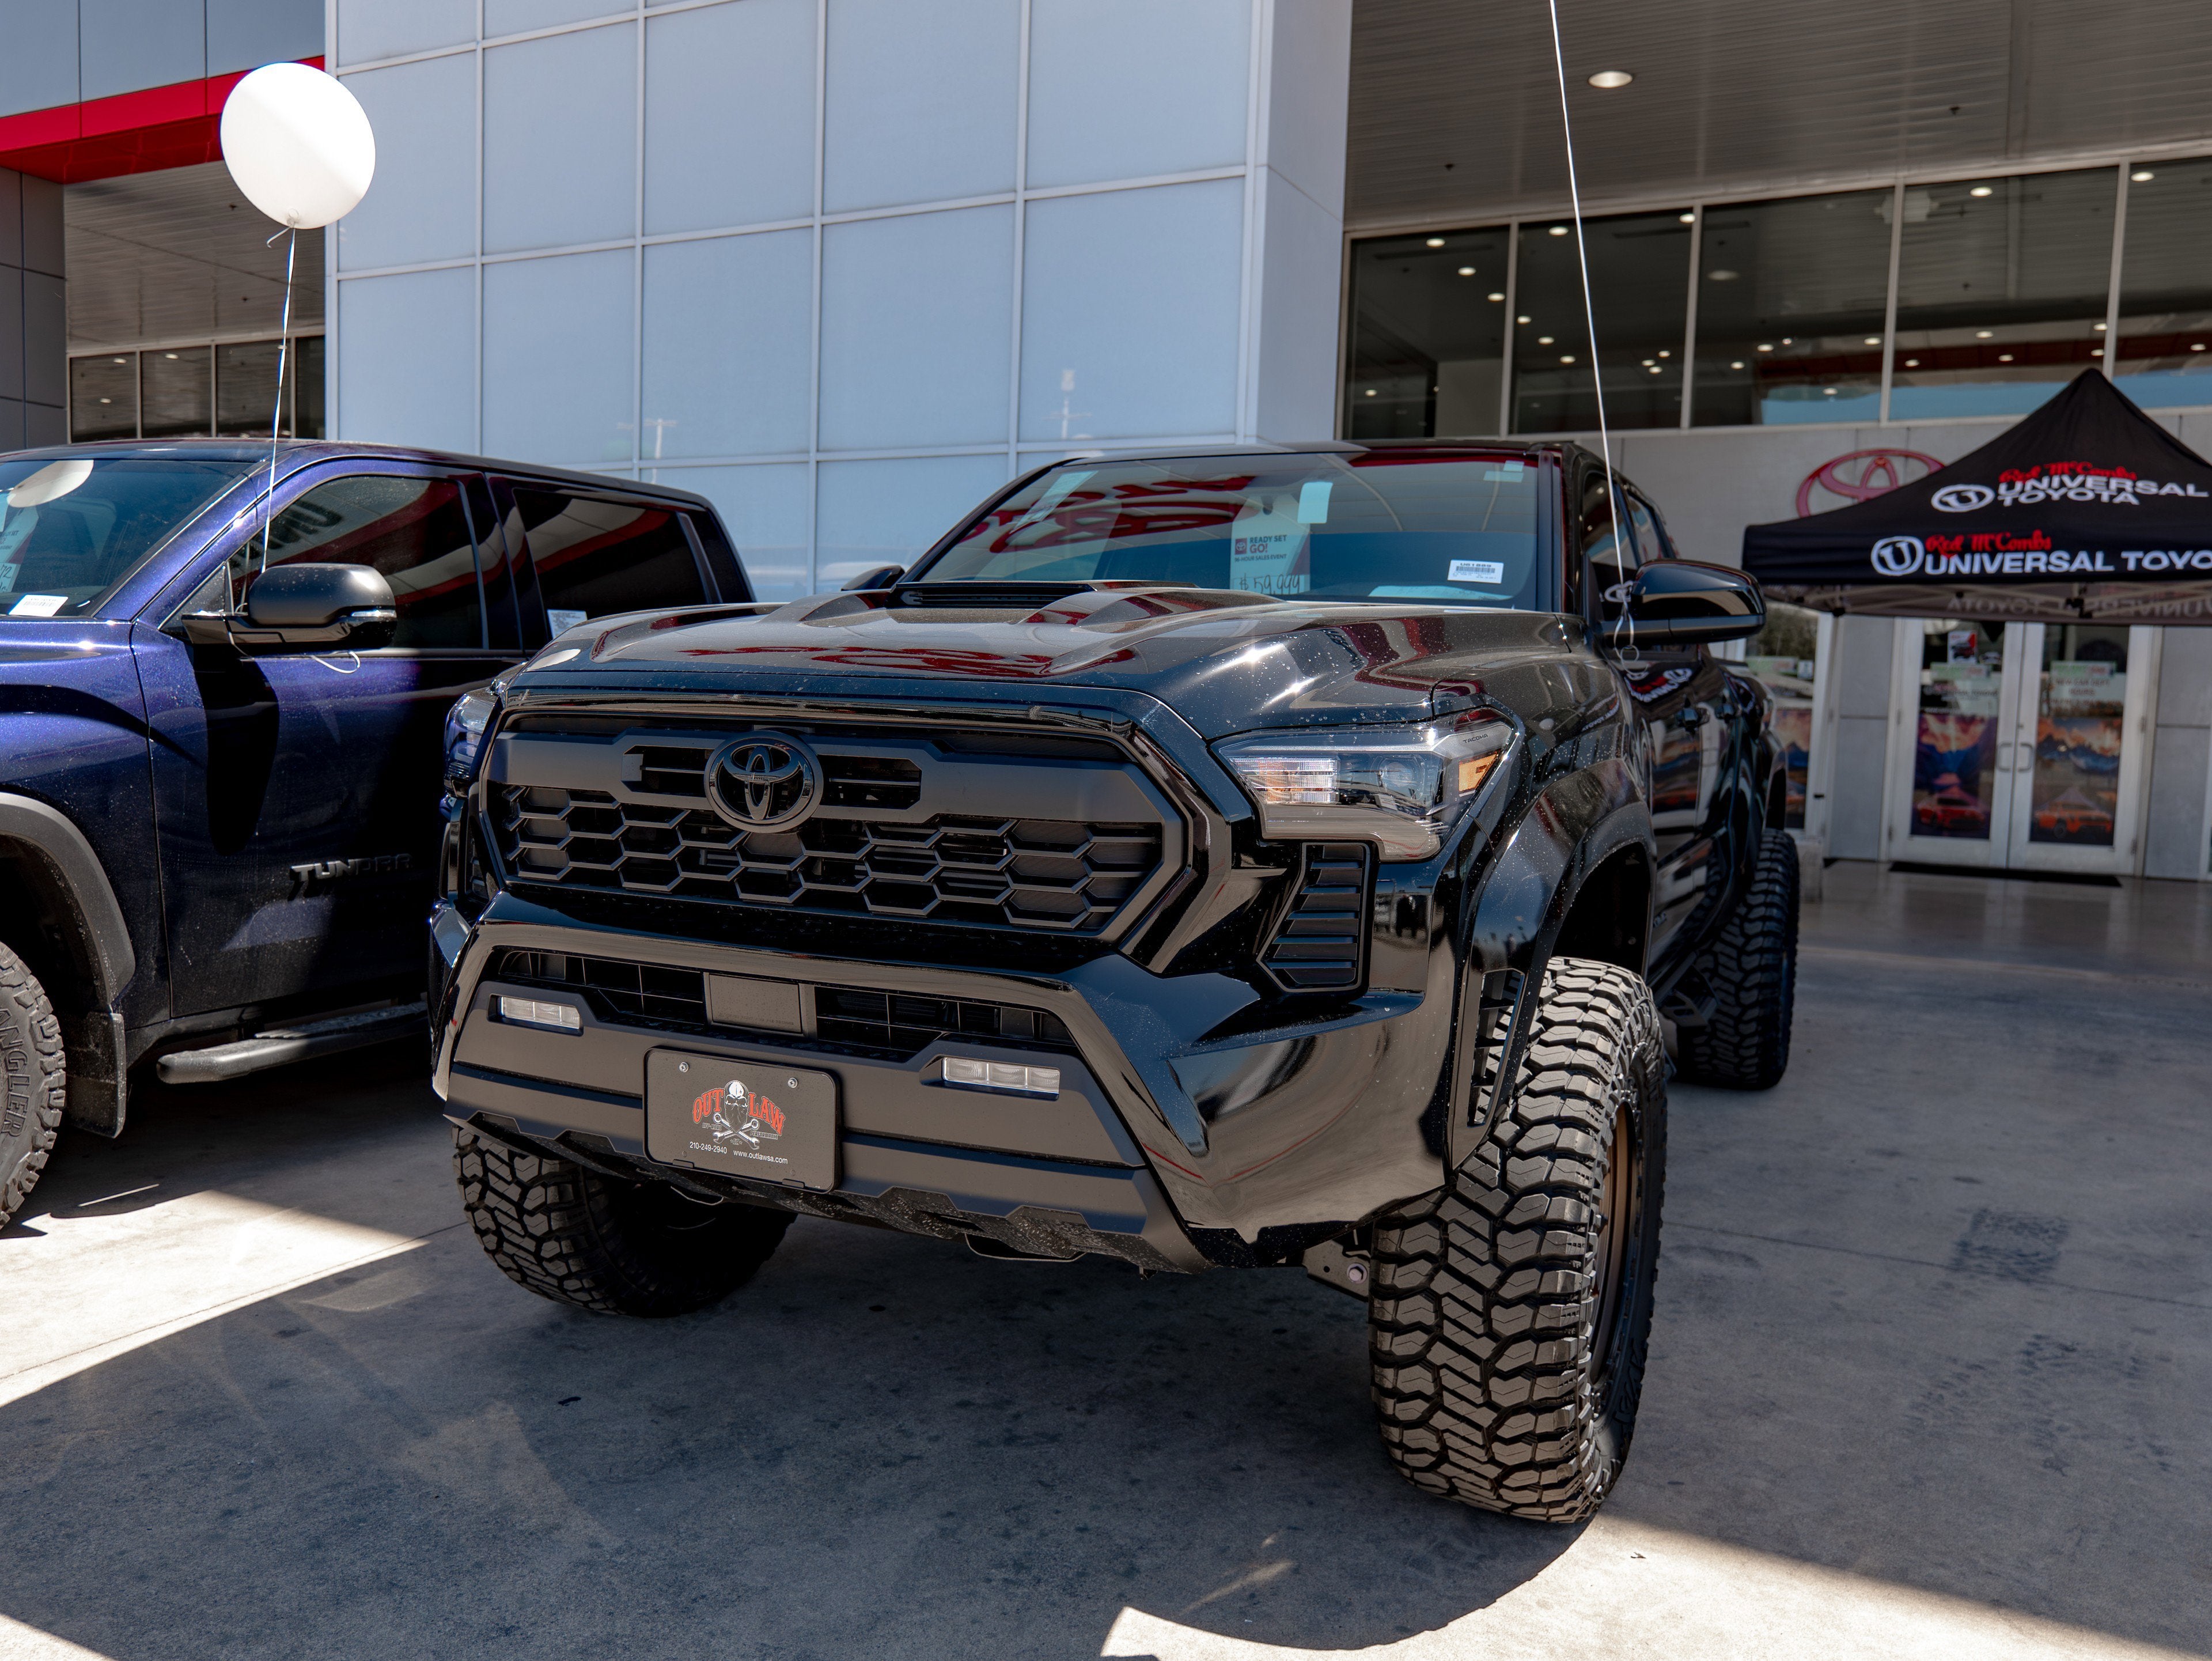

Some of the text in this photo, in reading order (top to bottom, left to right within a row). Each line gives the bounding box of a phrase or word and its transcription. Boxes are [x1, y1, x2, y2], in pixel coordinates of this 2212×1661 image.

[1999, 474, 2210, 497] UNIVERSAL
[1998, 488, 2140, 507] TOYOTA
[1249, 543, 1268, 553] GO!
[1926, 529, 2052, 559] Red McCombs
[1925, 550, 2212, 575] UNIVERSAL TOYO
[1463, 733, 1488, 743] TACOMA
[290, 853, 413, 881] TUNDRA
[690, 1141, 788, 1164] 210-249-2940 www.outlawsa.com
